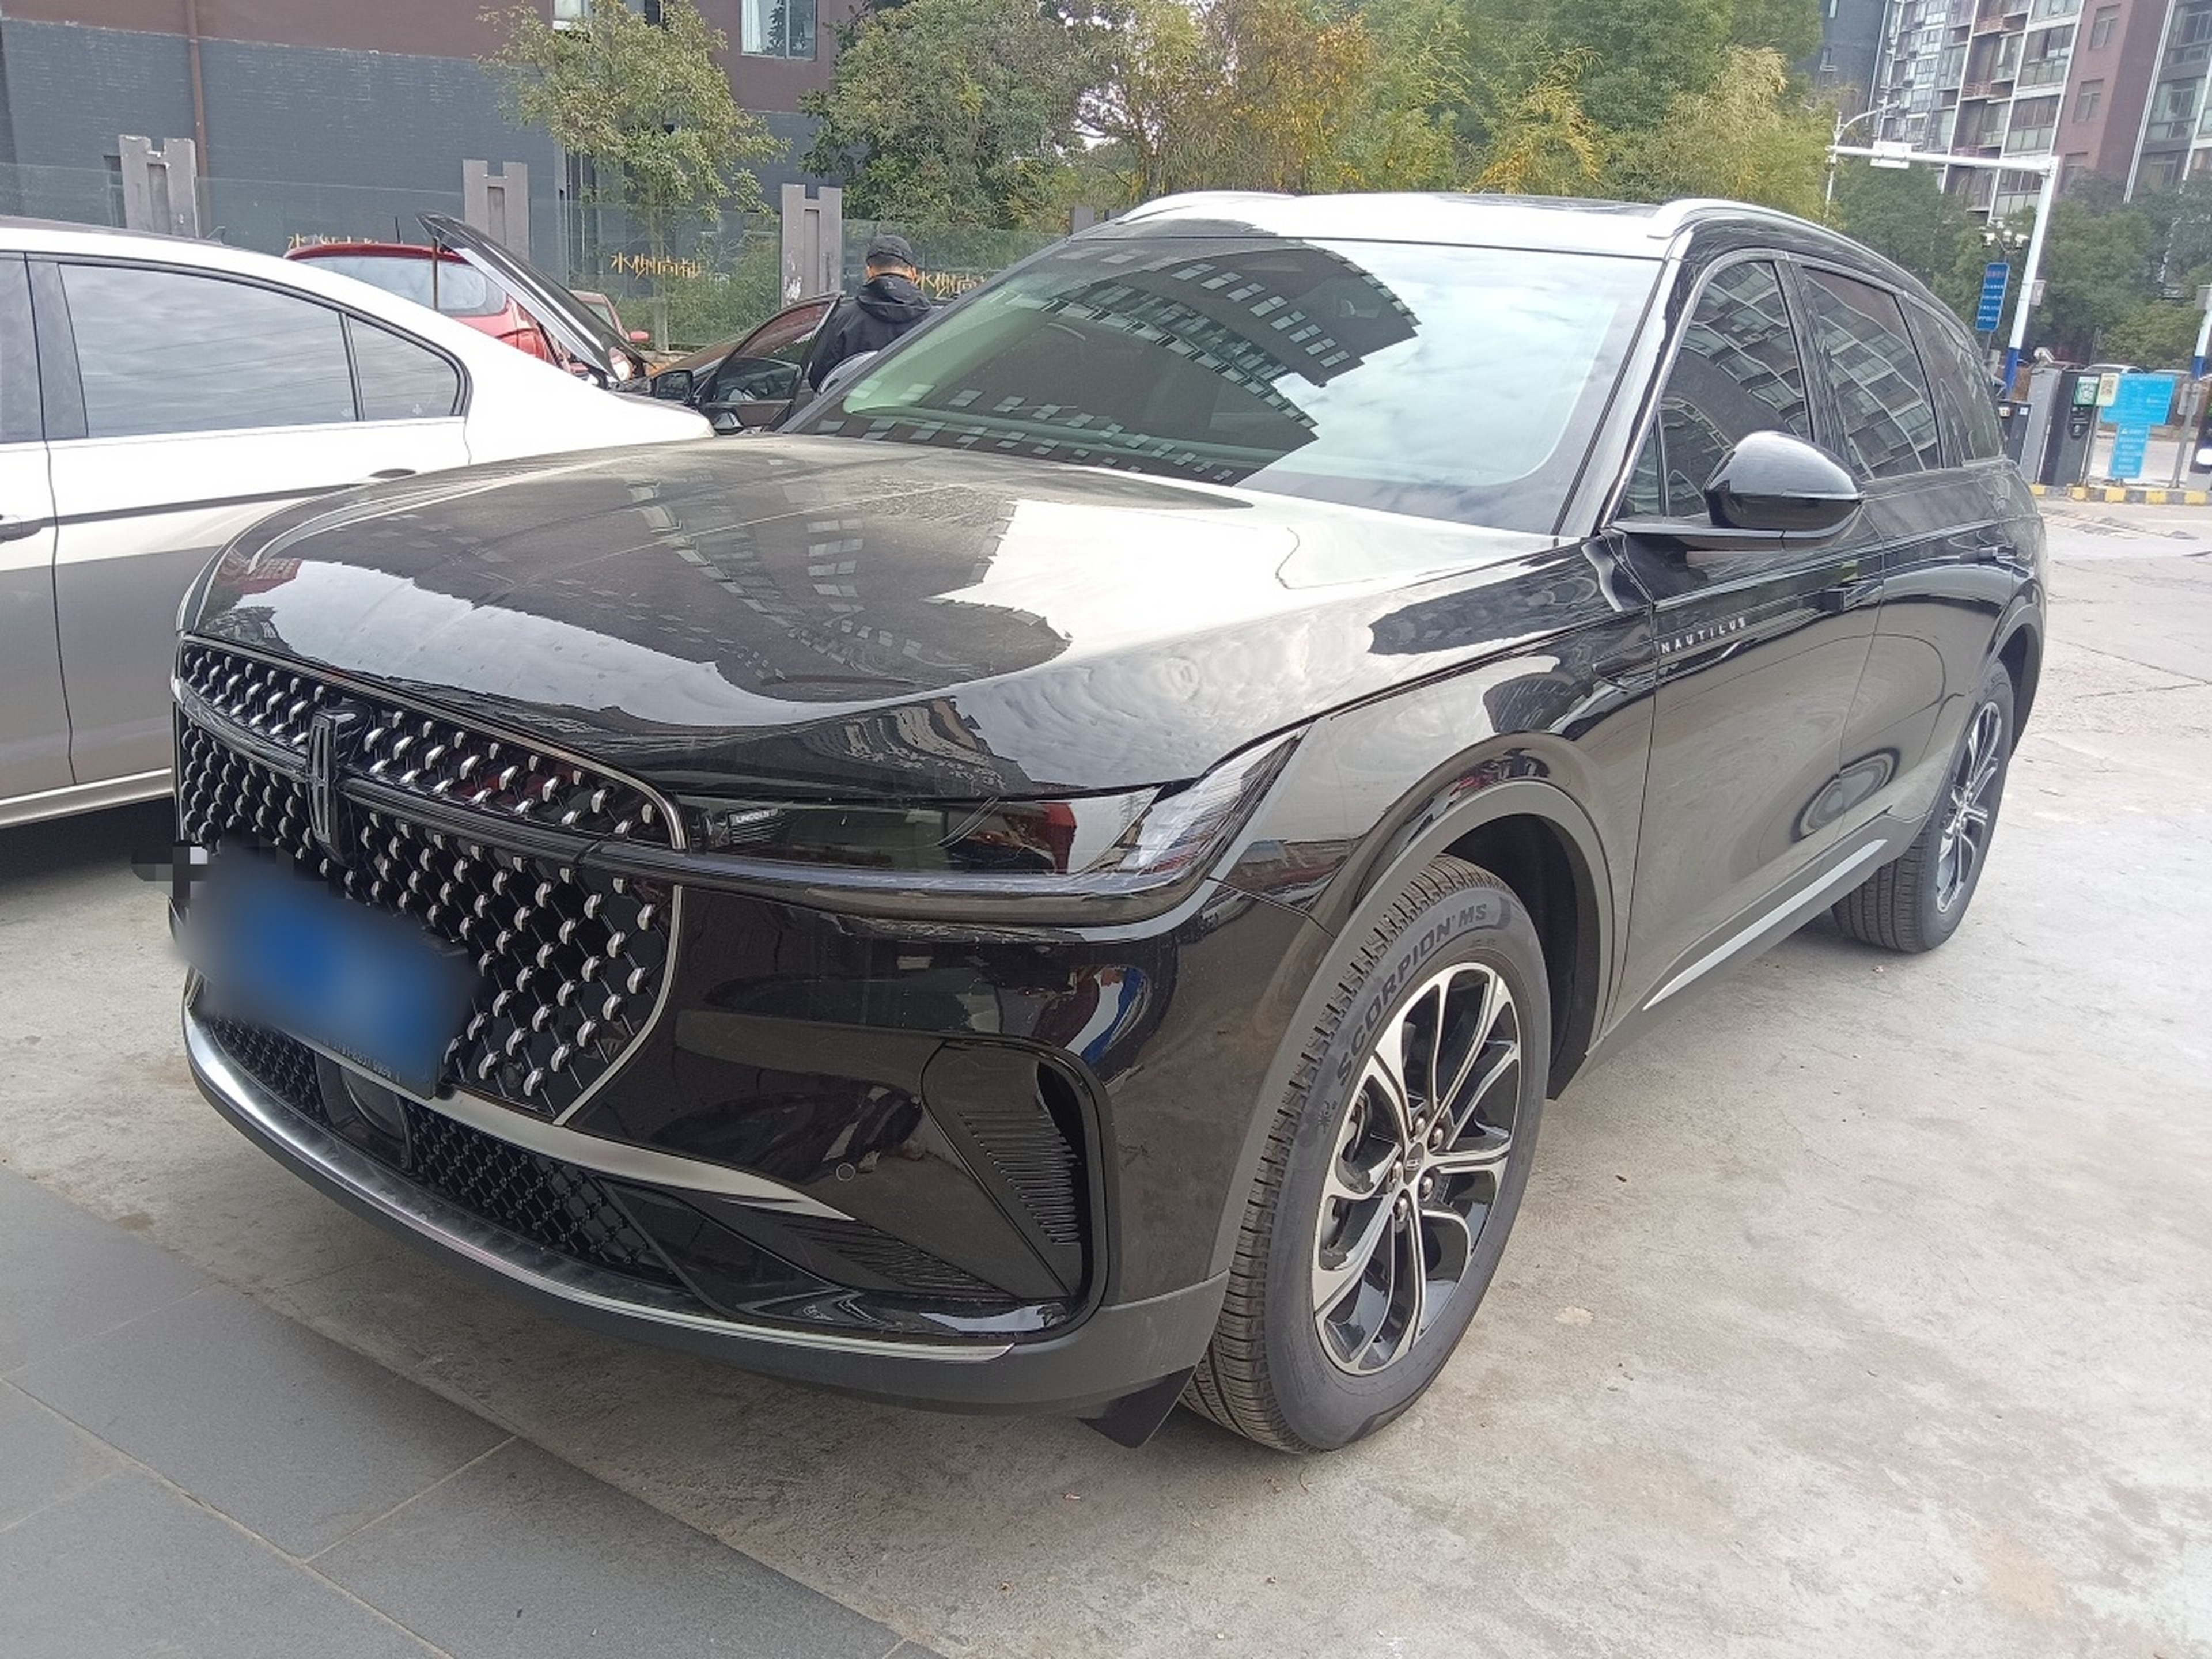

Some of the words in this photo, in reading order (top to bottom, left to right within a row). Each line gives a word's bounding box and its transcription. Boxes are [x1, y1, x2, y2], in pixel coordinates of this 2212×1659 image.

[1661, 617, 1747, 654] NAUTILUS
[1337, 918, 1452, 1086] SCORPION
[1459, 904, 1487, 928] MS
